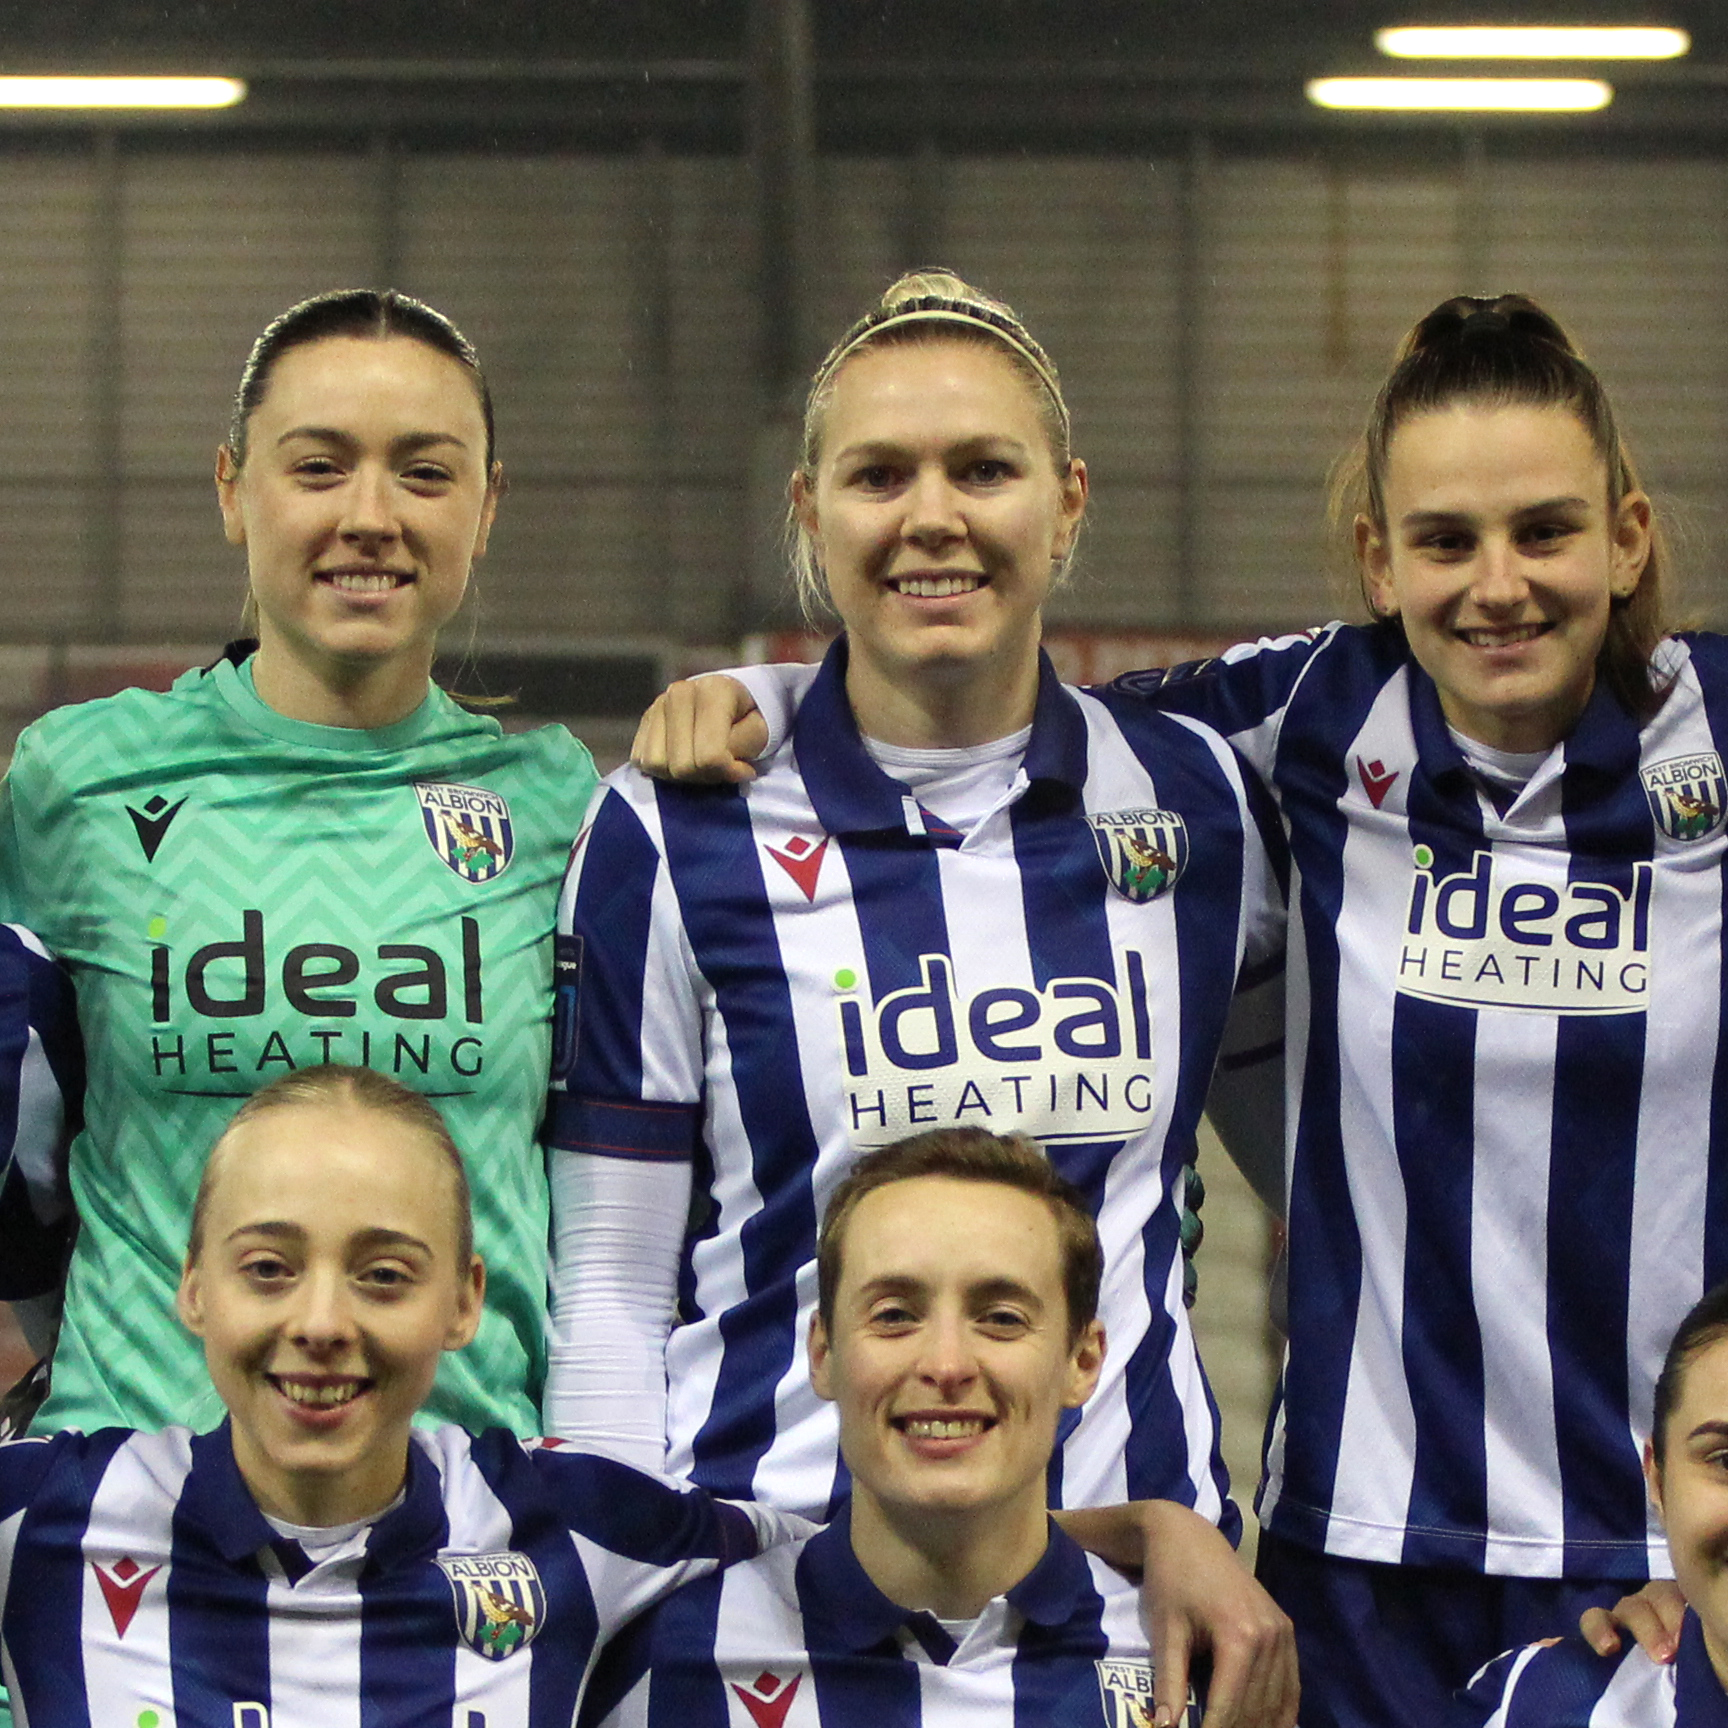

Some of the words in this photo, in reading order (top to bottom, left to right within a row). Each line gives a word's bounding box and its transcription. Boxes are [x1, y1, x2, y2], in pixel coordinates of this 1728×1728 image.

[1650, 763, 1718, 788] ALBION
[424, 792, 503, 816] ALBION
[1096, 810, 1177, 827] ALBION
[1408, 844, 1654, 952] ideal
[146, 909, 483, 1024] ideal
[1400, 945, 1648, 994] HEATING
[834, 949, 1152, 1077] ideal
[152, 1030, 485, 1076] HEATING
[850, 1072, 1152, 1130] HEATING
[452, 1560, 531, 1577] ALBION
[1108, 1672, 1154, 1694] ALBI
